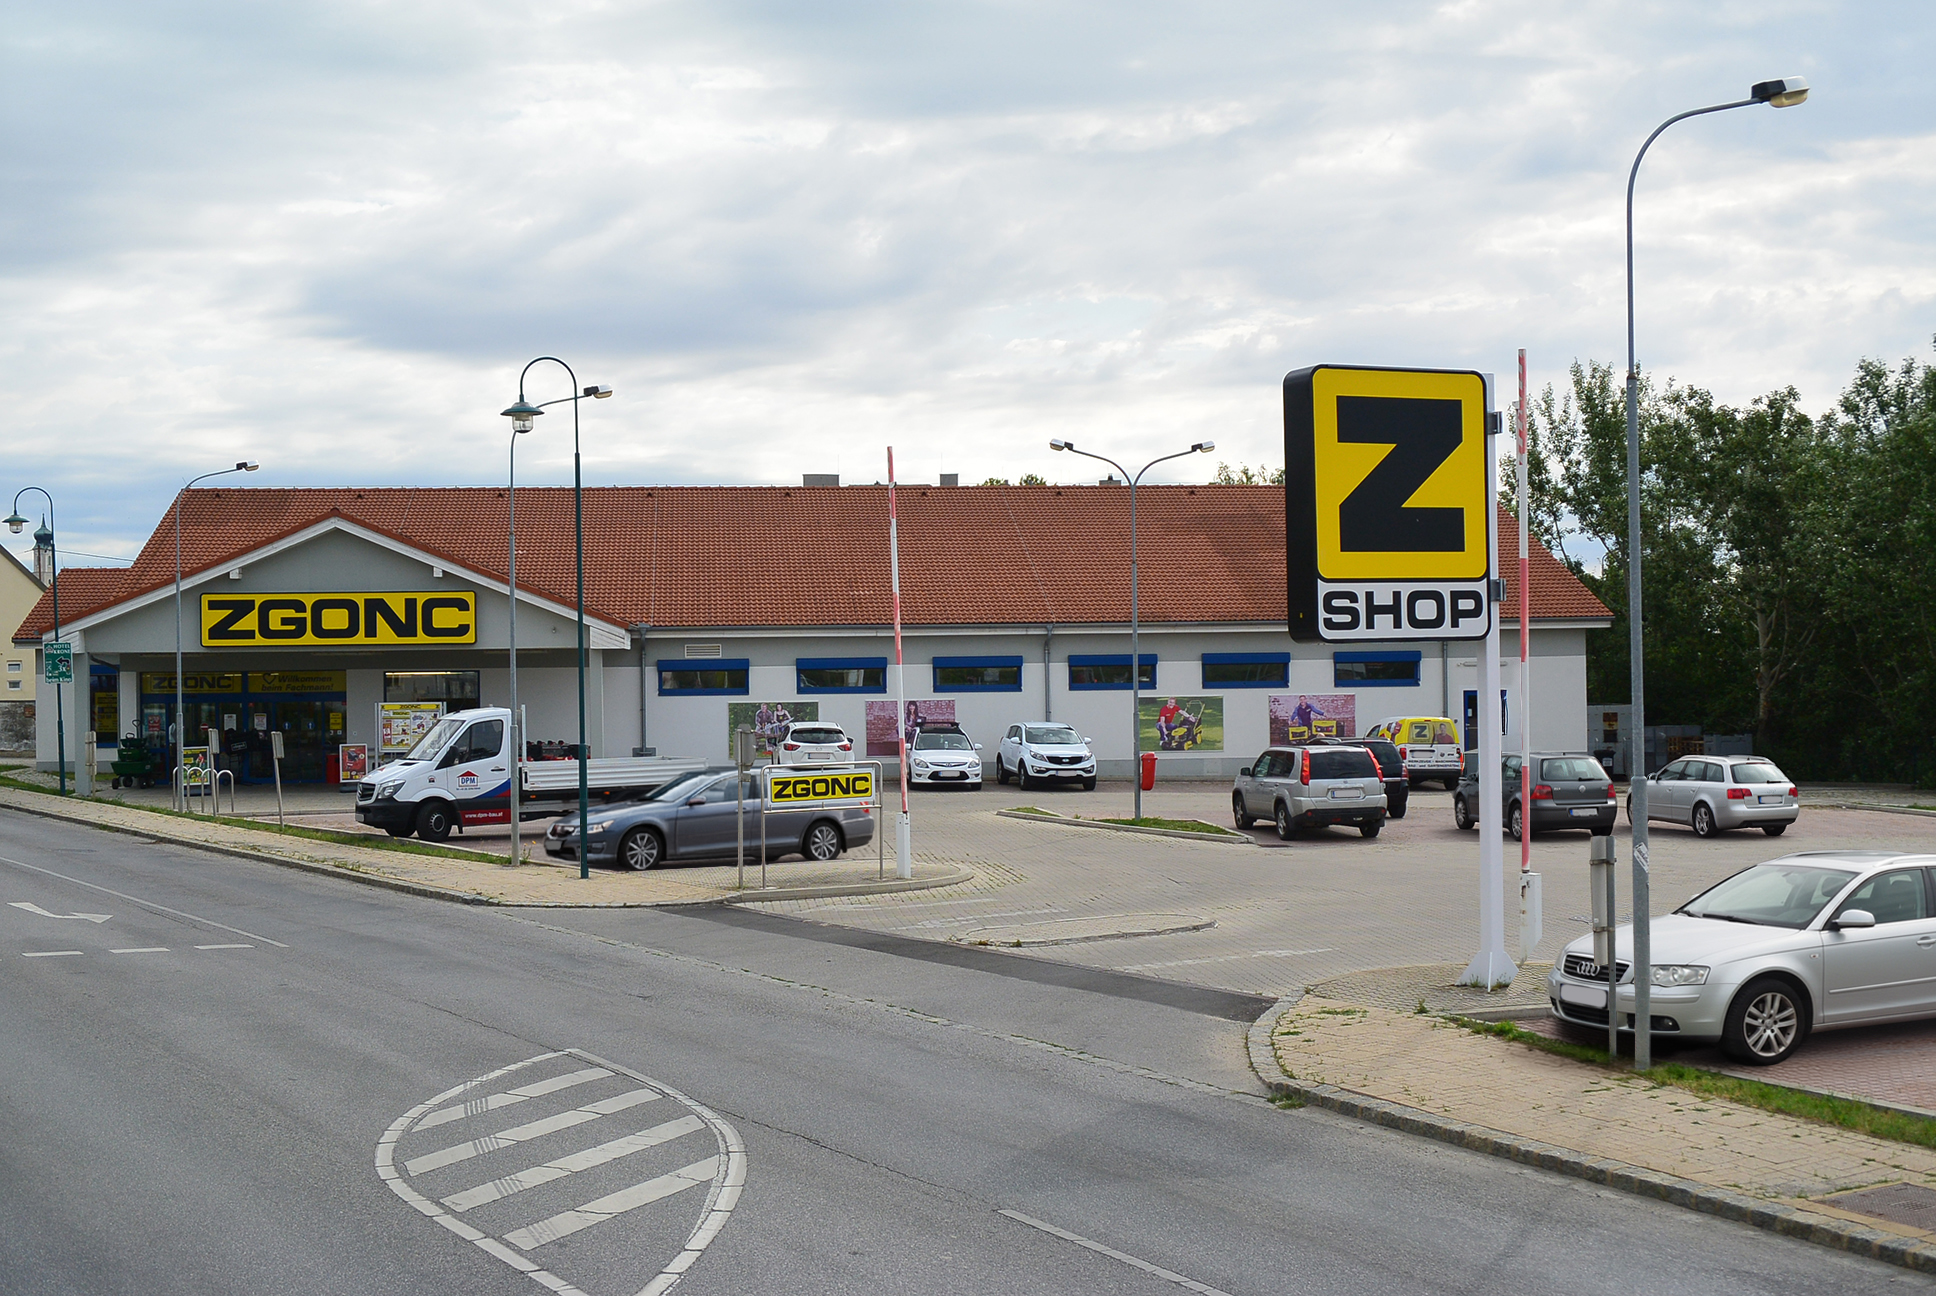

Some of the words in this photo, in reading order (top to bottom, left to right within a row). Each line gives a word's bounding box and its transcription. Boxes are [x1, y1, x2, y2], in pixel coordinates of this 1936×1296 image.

[1336, 395, 1465, 552] Z
[208, 597, 470, 640] ZGONC
[1322, 589, 1484, 631] SHOP
[153, 676, 232, 689] ZGONC
[279, 674, 332, 682] Willkommen
[285, 683, 334, 691] Fachmann!
[1414, 726, 1427, 738] Z
[774, 776, 869, 799] ZGONC
